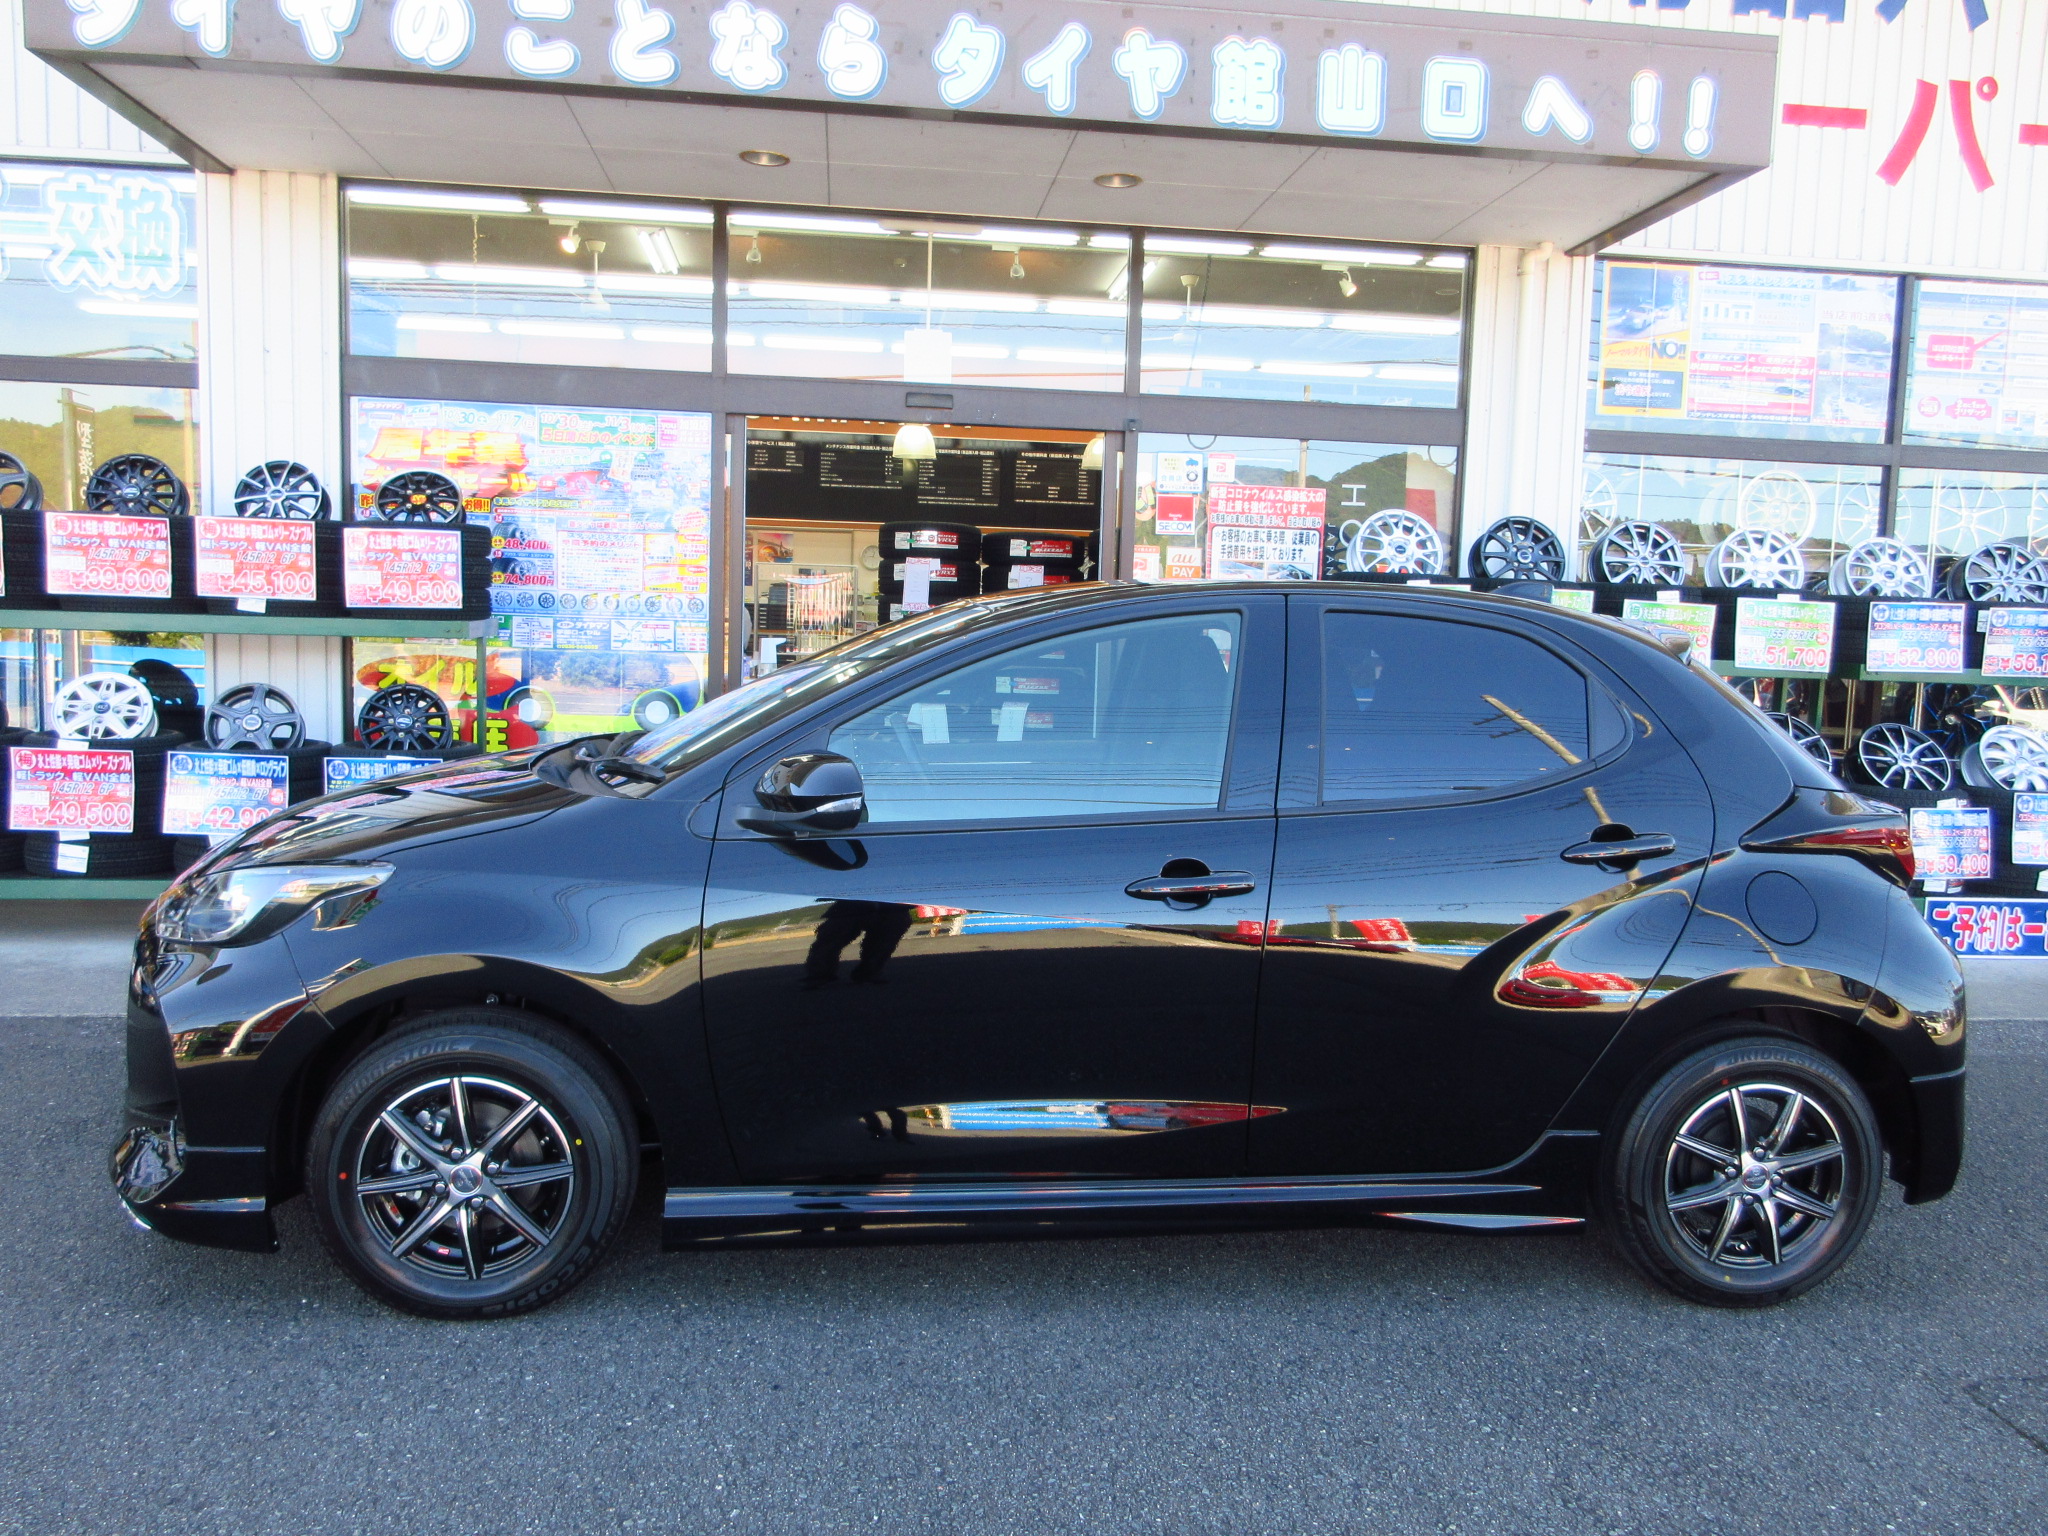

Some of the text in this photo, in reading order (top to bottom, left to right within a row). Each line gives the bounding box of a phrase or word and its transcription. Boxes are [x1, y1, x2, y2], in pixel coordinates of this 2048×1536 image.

[1210, 486, 1325, 504] 新型コロナウイルス感染拡大の
[1217, 499, 1312, 516] 防止策を強化しています。
[1158, 521, 1192, 532] SECOM
[88, 547, 151, 562] 145R12 6P
[1326, 522, 1336, 576] JAPAN
[237, 551, 298, 565] 145R12 6P
[1171, 553, 1195, 564] au
[382, 561, 443, 574] 145R12 6P
[1172, 567, 1195, 577] PAY
[378, 658, 478, 696] オイル
[52, 781, 115, 795] 145R12 6P
[207, 786, 270, 801] 145R12 6P
[188, 805, 284, 830] ¥42.90
[1932, 903, 2048, 951] ご予約は一
